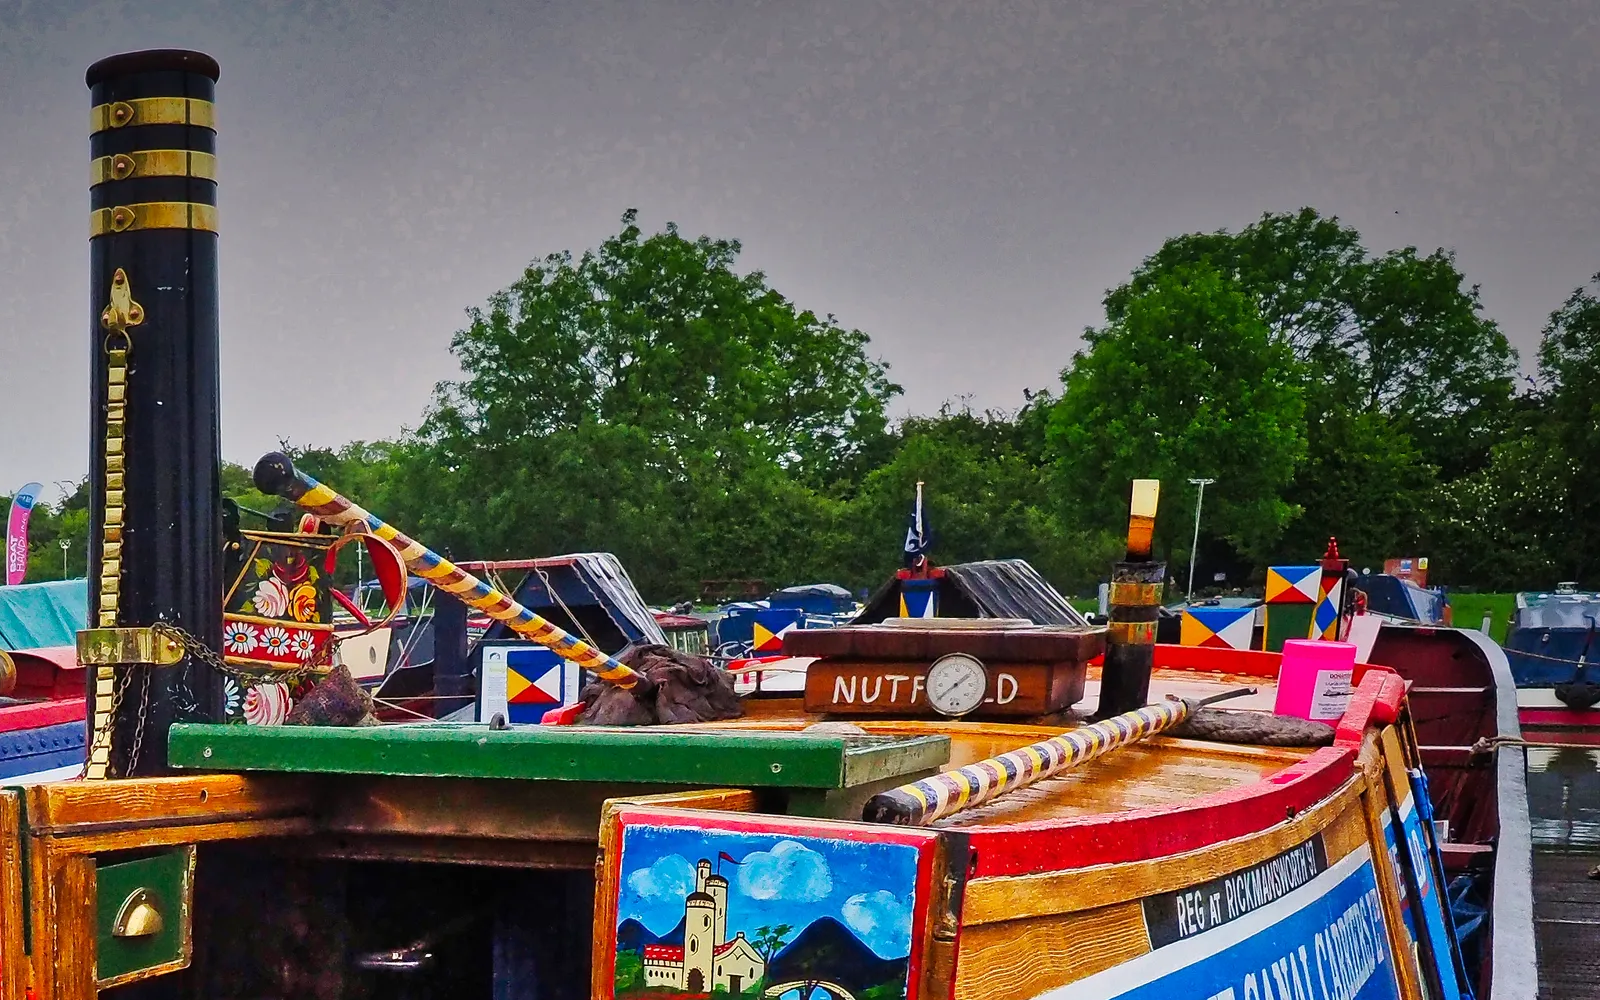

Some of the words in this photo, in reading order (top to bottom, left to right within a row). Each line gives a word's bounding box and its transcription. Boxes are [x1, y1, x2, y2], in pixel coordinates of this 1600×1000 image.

[10, 534, 18, 573] BOAT
[832, 673, 1018, 704] NUTFD
[1176, 890, 1206, 938] REG
[1209, 891, 1223, 927] AT
[1224, 844, 1309, 919] RICKMANSWORTH
